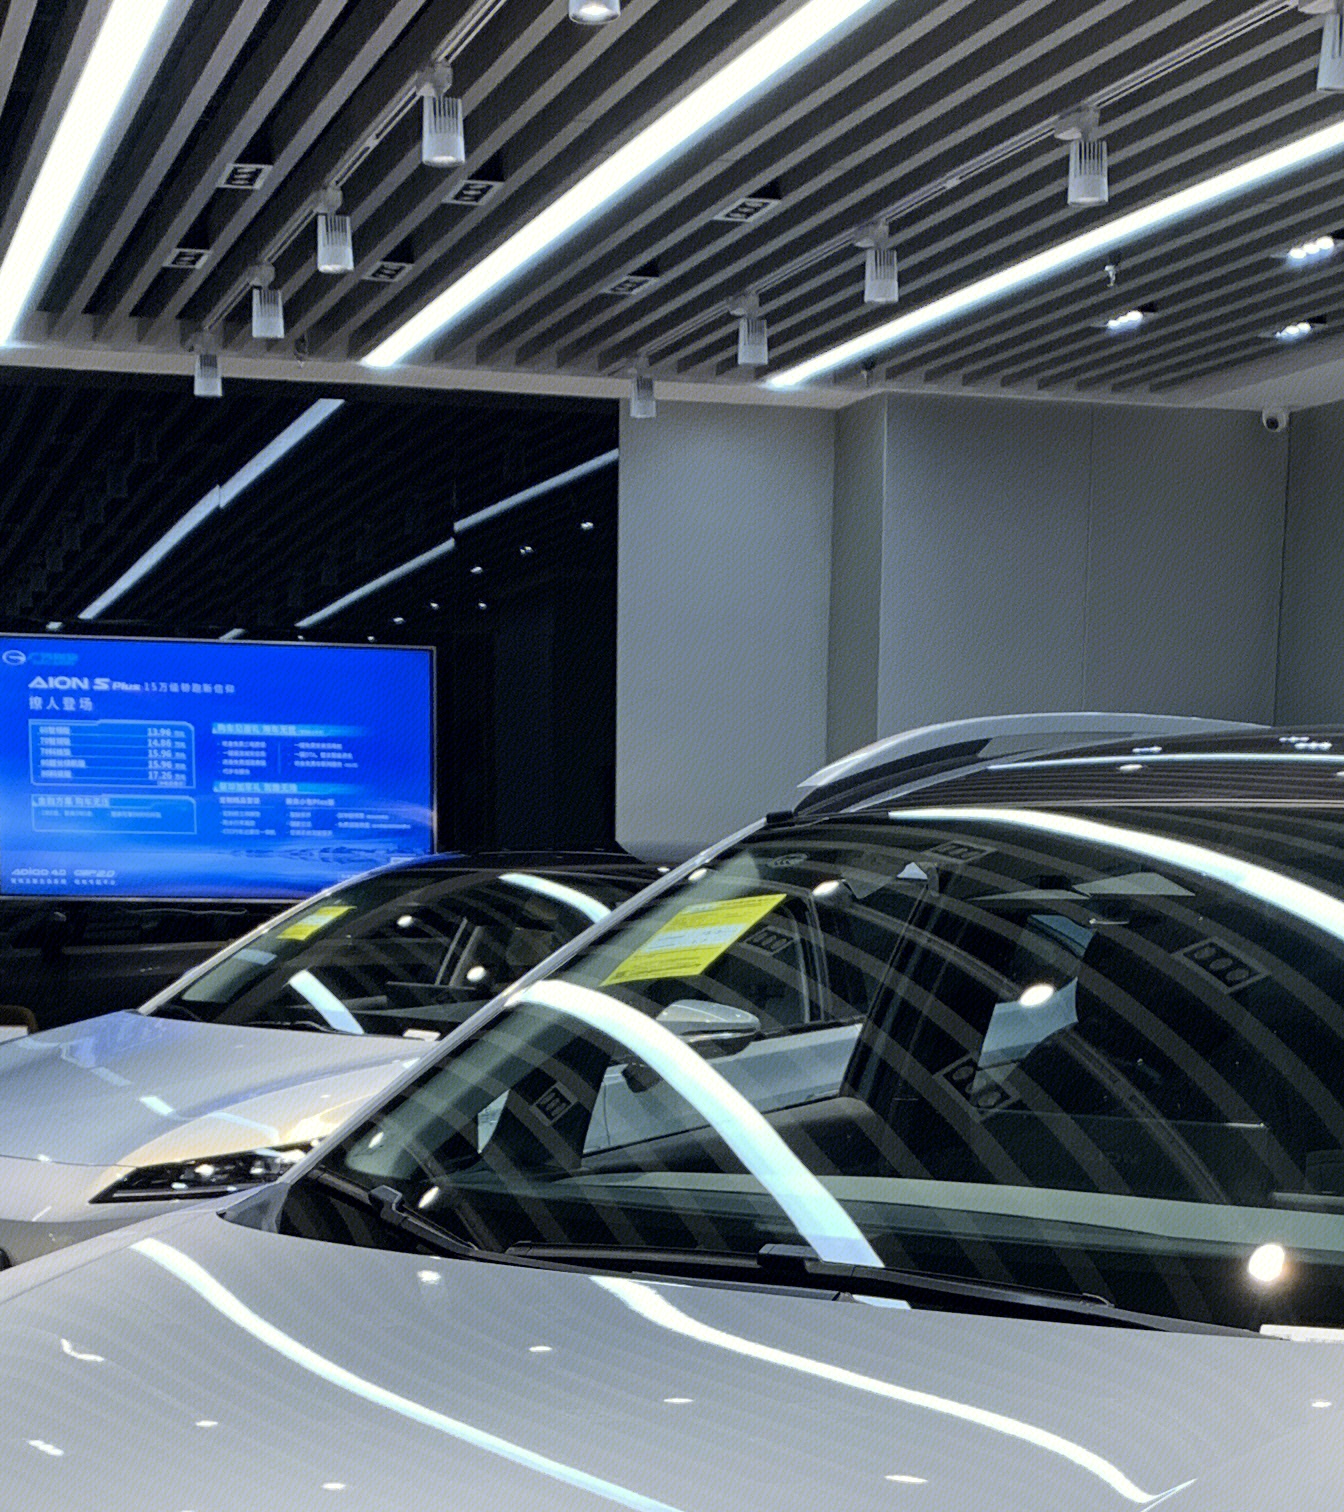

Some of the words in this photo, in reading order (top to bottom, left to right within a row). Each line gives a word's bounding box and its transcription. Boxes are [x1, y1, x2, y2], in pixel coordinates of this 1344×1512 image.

[28, 675, 89, 690] AION
[93, 677, 111, 691] S
[112, 681, 141, 691] Plus
